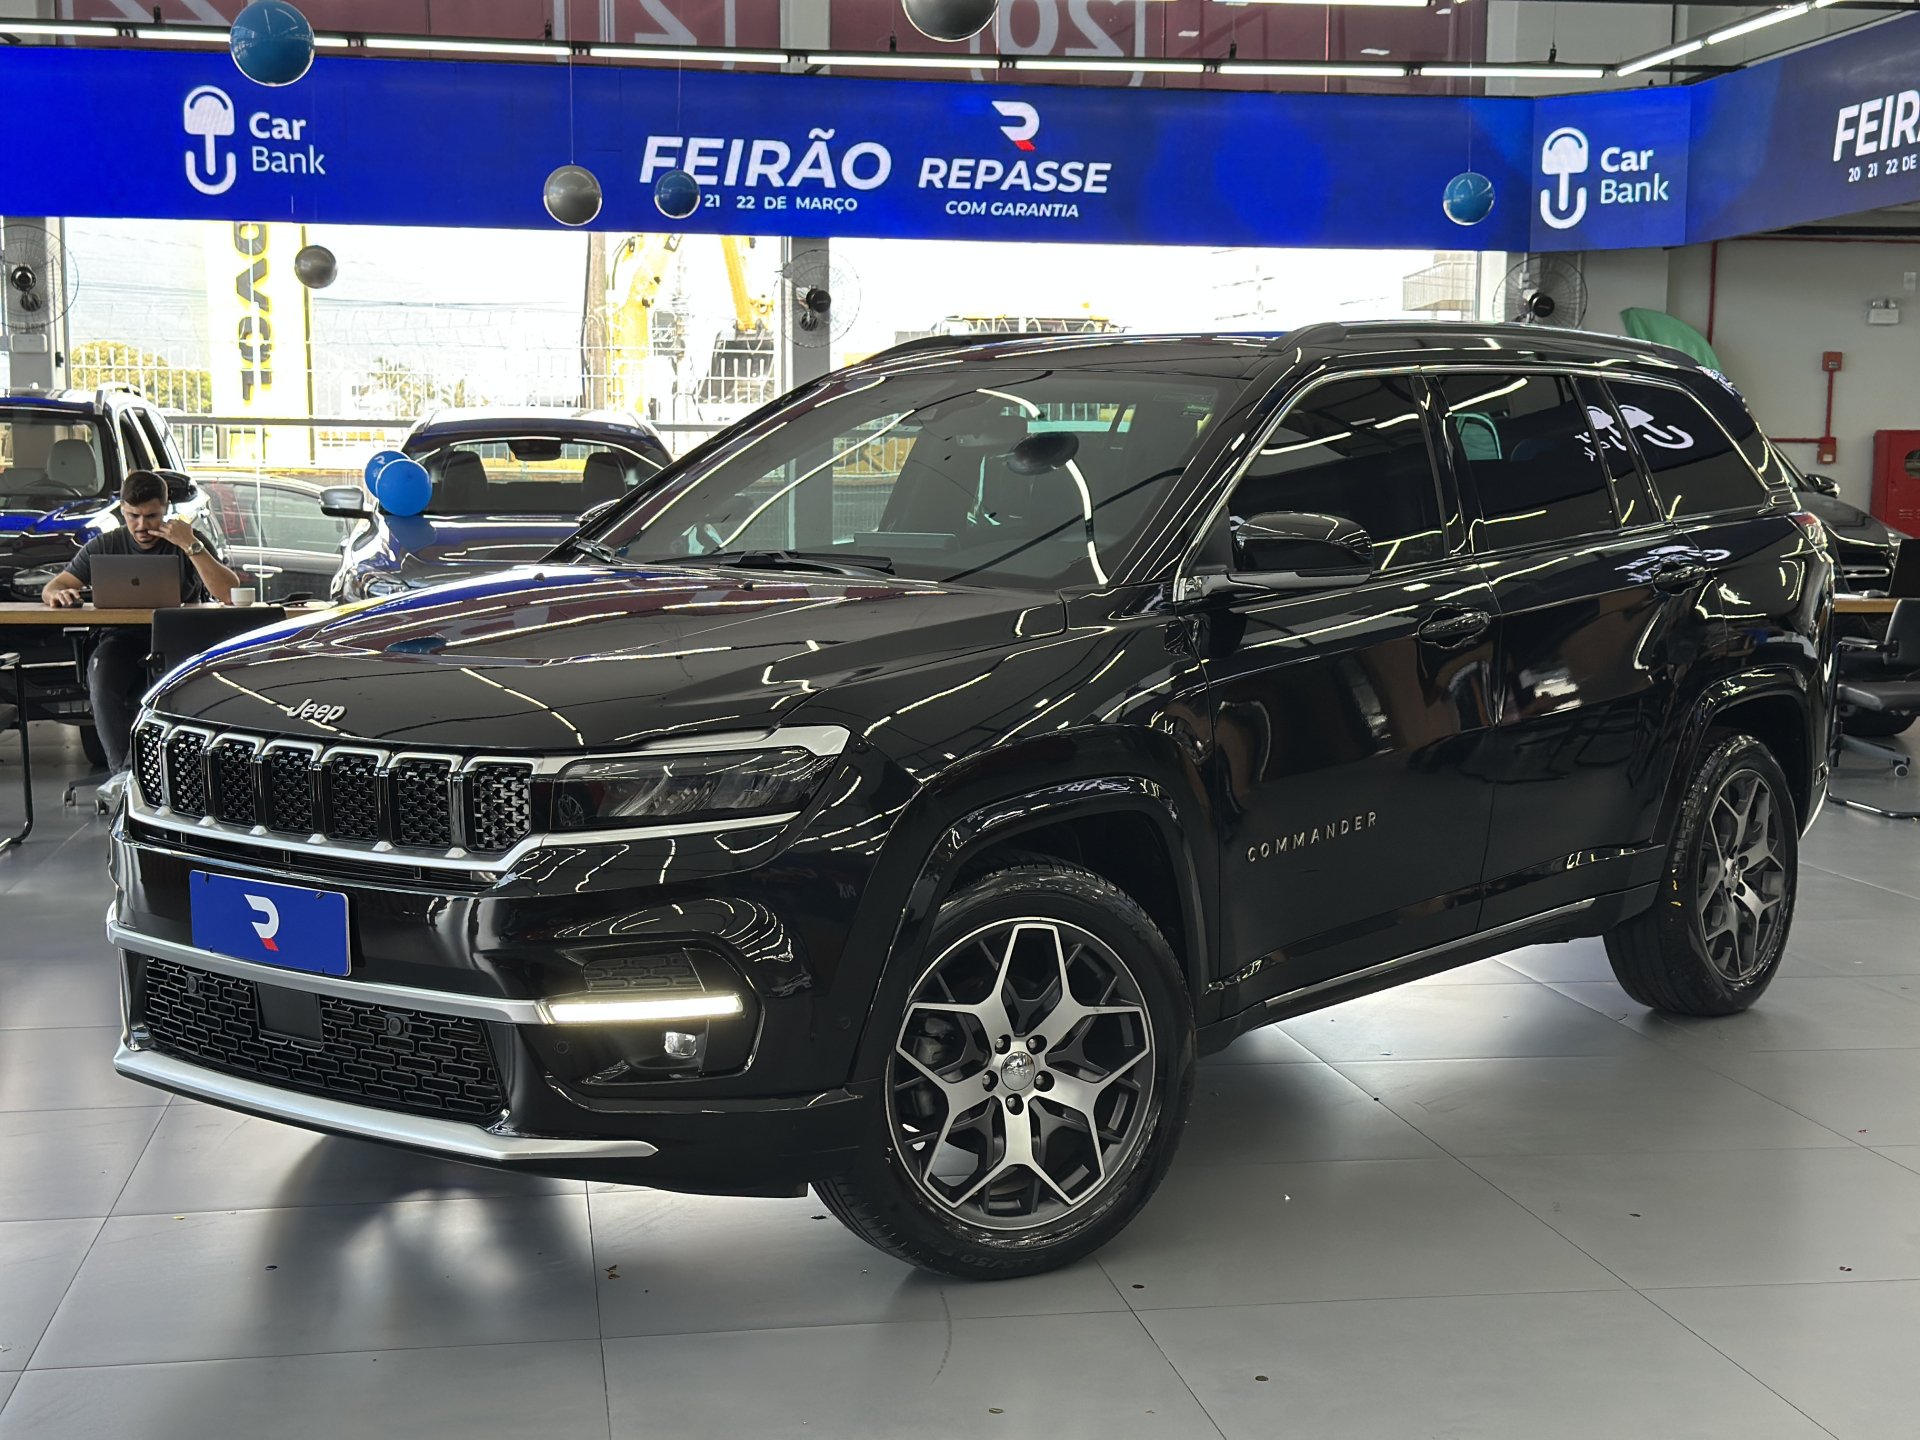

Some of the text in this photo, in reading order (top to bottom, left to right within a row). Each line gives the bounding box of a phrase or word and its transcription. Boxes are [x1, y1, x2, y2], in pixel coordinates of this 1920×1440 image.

[249, 111, 307, 141] Car
[1833, 90, 1920, 162] FEIR
[251, 145, 326, 175] Bank
[639, 127, 892, 190] FEIRÃO
[1600, 146, 1654, 173] Car
[1848, 153, 1918, 183] 20 21 22 DE
[918, 157, 1112, 194] REPASSE
[1600, 172, 1669, 204] Bank
[704, 194, 858, 214] 21 22 DE MARÇO
[945, 200, 1079, 218] COM GARANTIA
[286, 698, 346, 724] Jeep
[1247, 811, 1377, 862] COMMANDER
